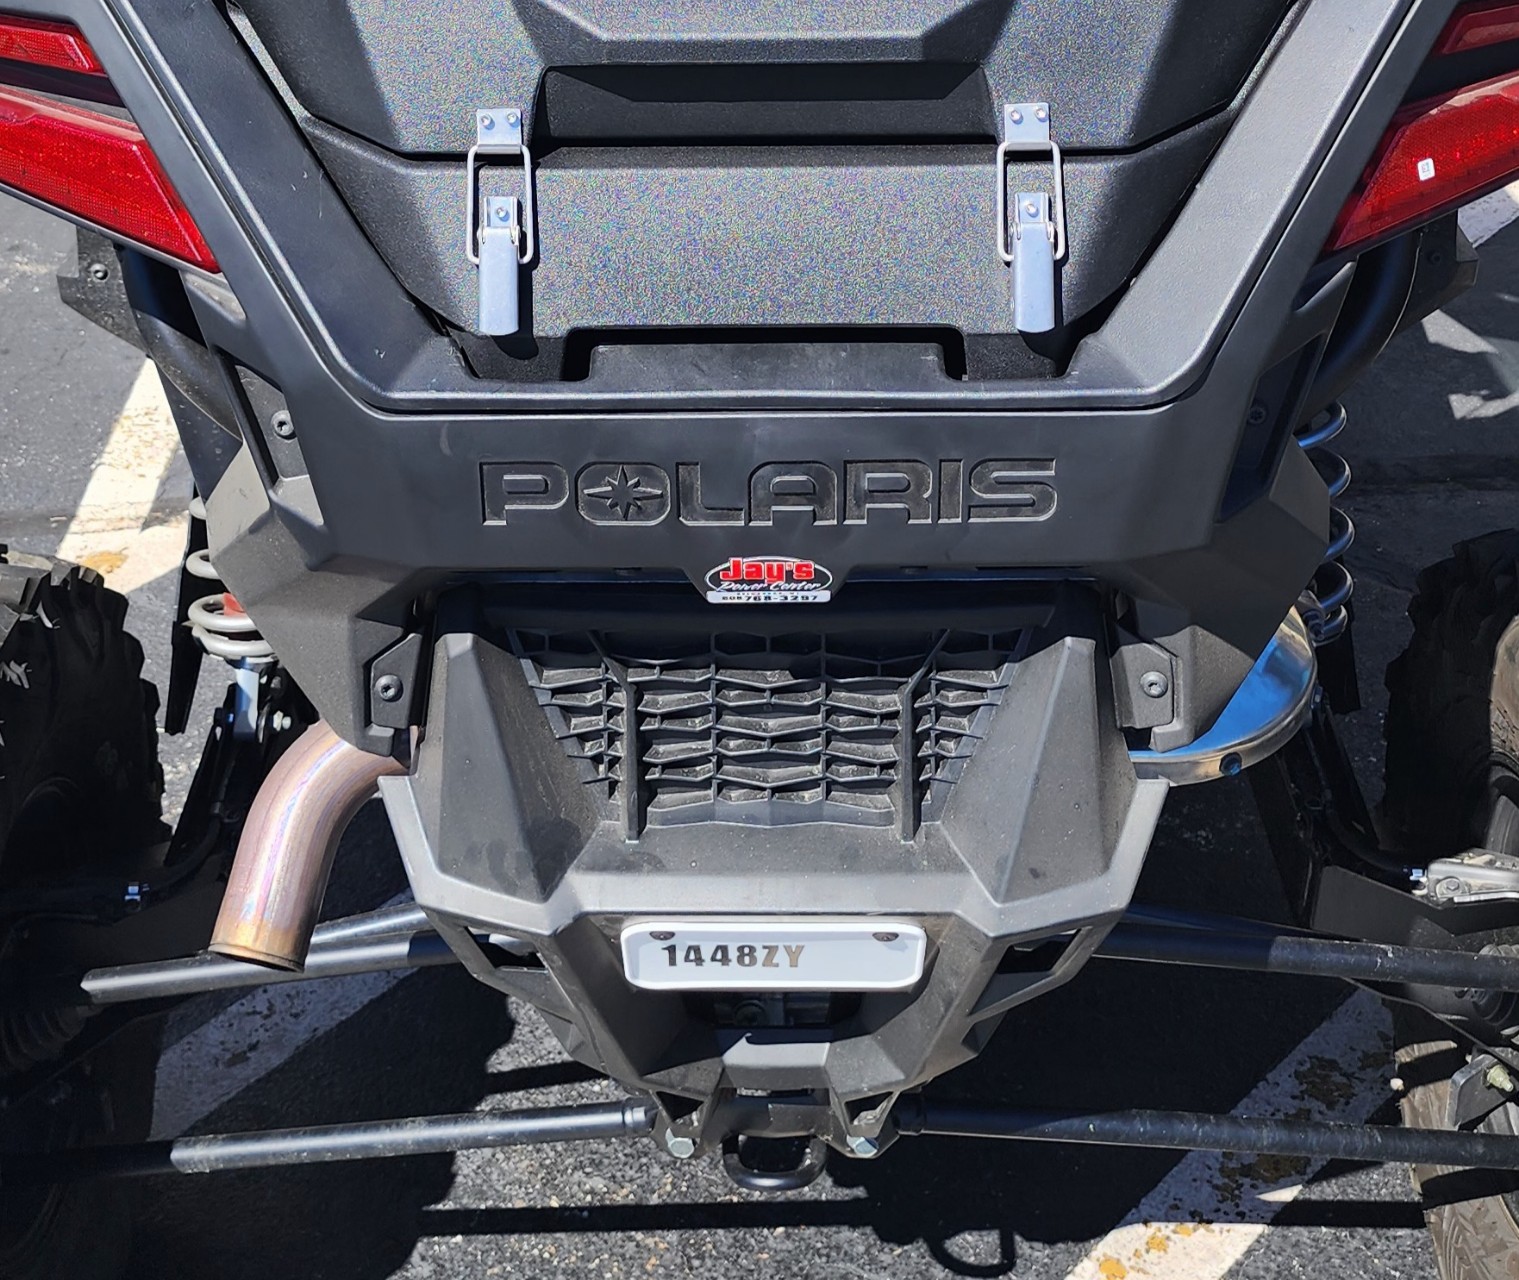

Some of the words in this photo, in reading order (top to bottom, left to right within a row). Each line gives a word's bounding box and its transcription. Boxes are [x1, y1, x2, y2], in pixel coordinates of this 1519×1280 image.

[479, 458, 1059, 527] POLARIS
[720, 557, 815, 584] Jay's
[717, 581, 768, 591] Power
[769, 581, 821, 591] Center
[661, 944, 805, 968] 1448ZY
